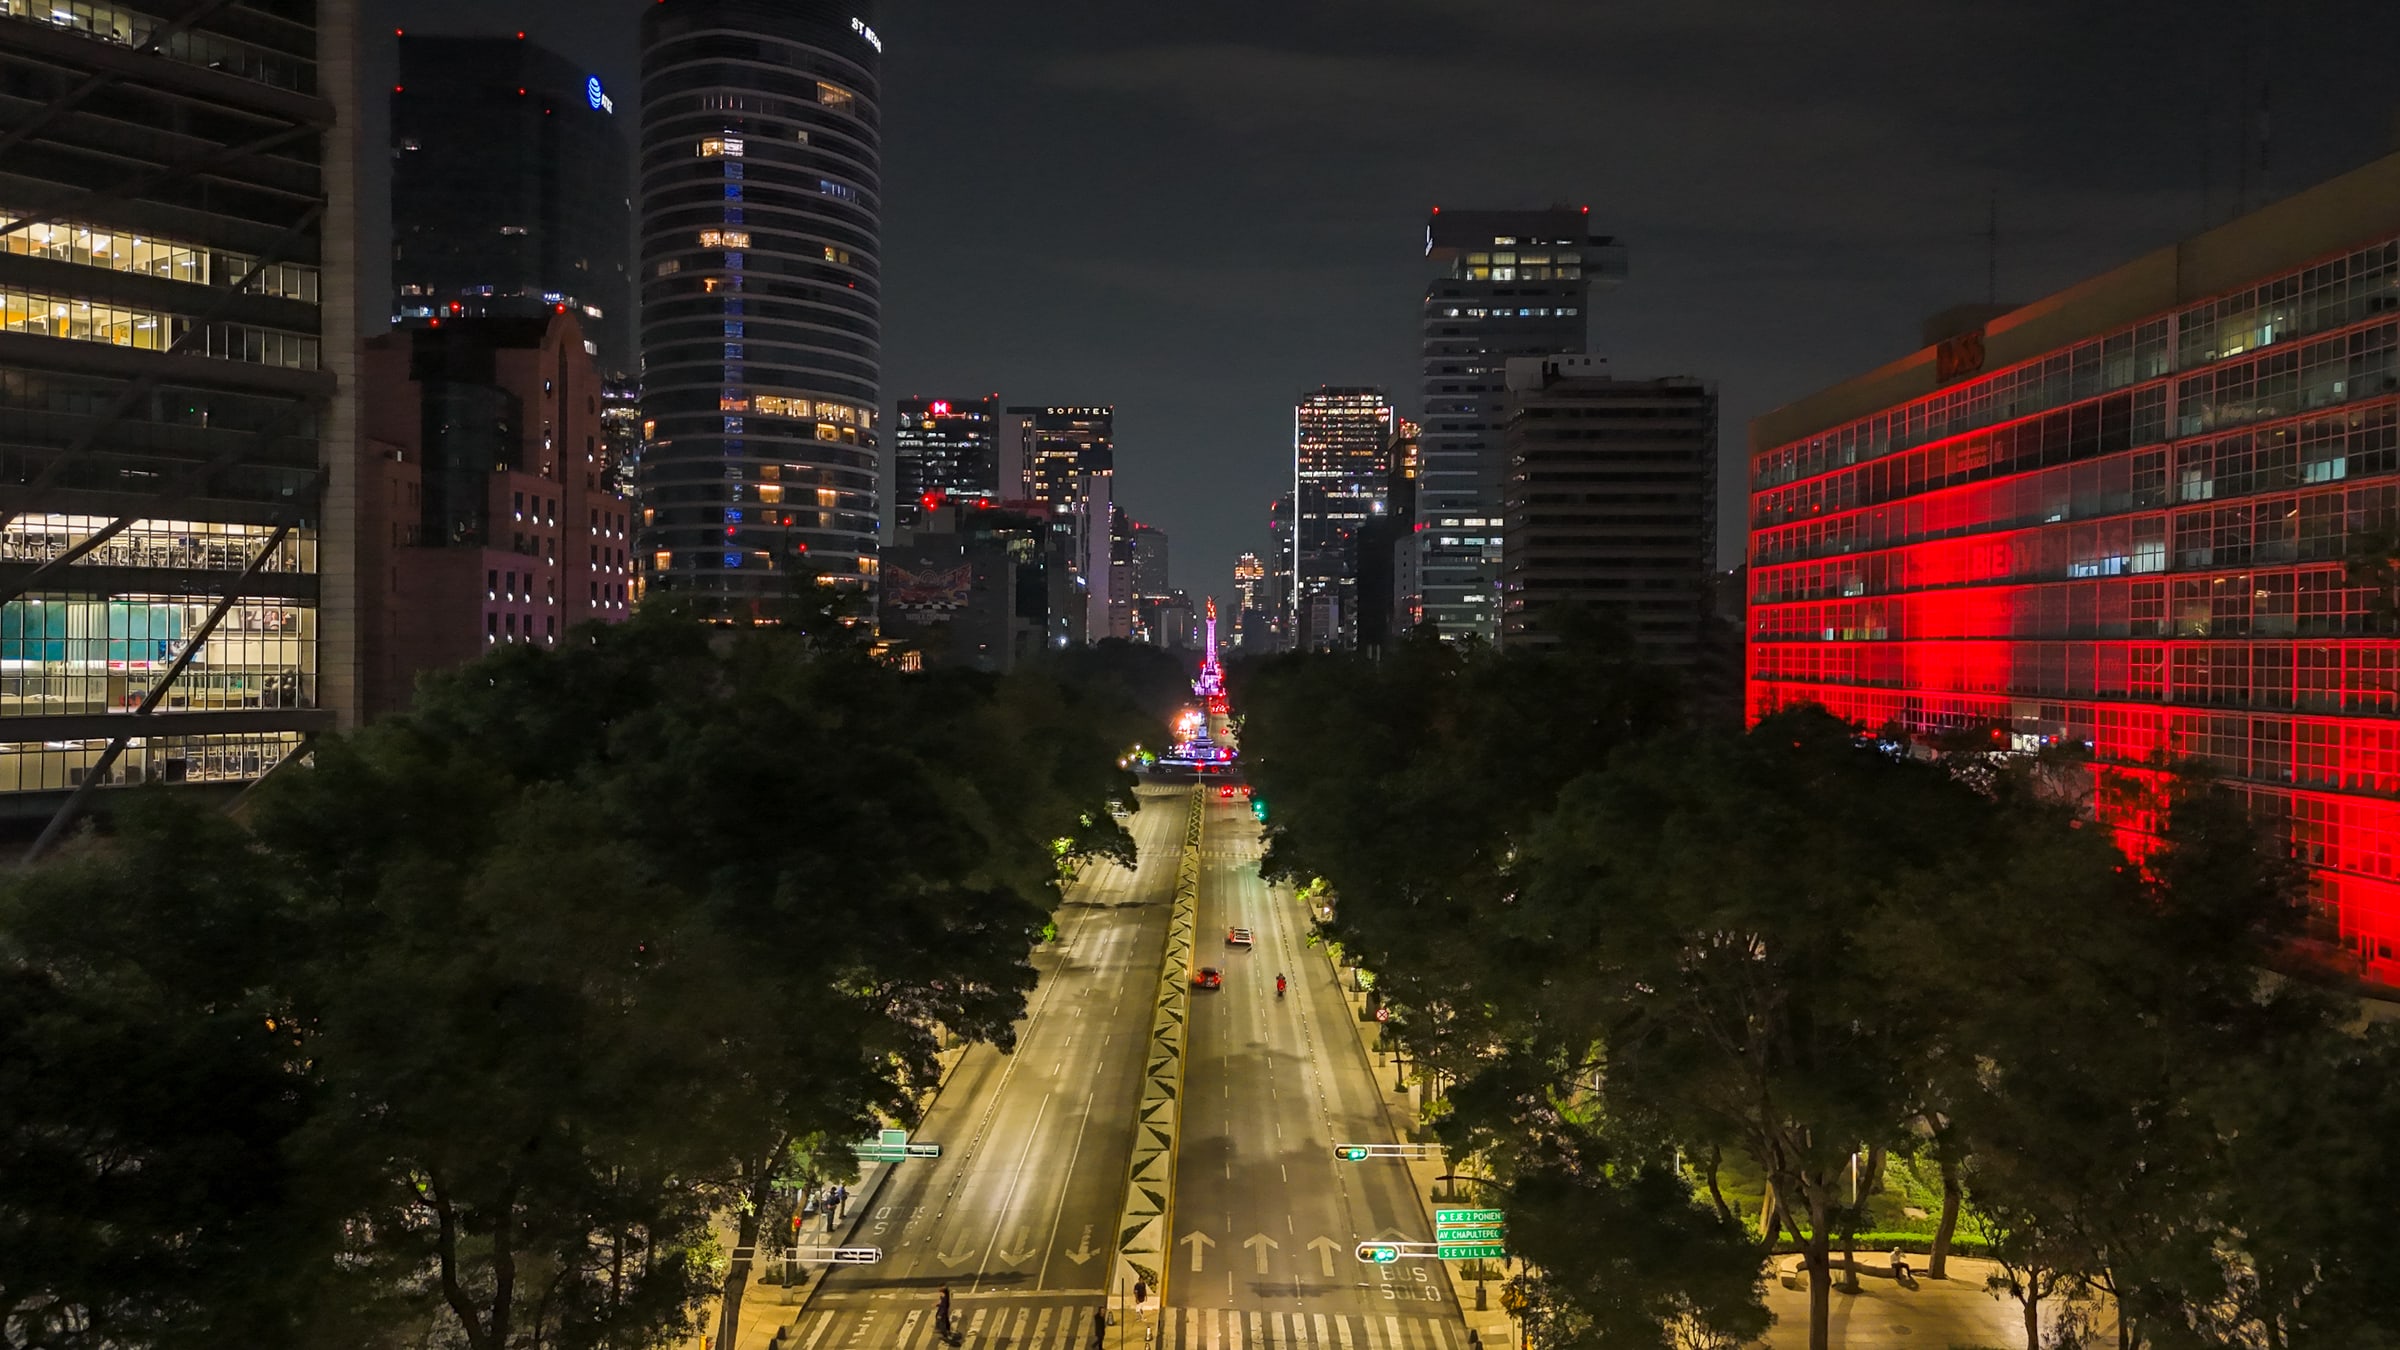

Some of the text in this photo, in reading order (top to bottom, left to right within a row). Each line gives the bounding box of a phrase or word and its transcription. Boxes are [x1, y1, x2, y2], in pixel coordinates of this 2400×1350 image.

[851, 17, 865, 35] ST
[1047, 406, 1109, 415] SOFITEL
[1440, 1230, 1499, 1239] AV. CHAPULTEPEC
[1444, 1248, 1496, 1257] SEVILLA
[1380, 1265, 1428, 1282] BUS
[1380, 1283, 1442, 1302] SOLO
